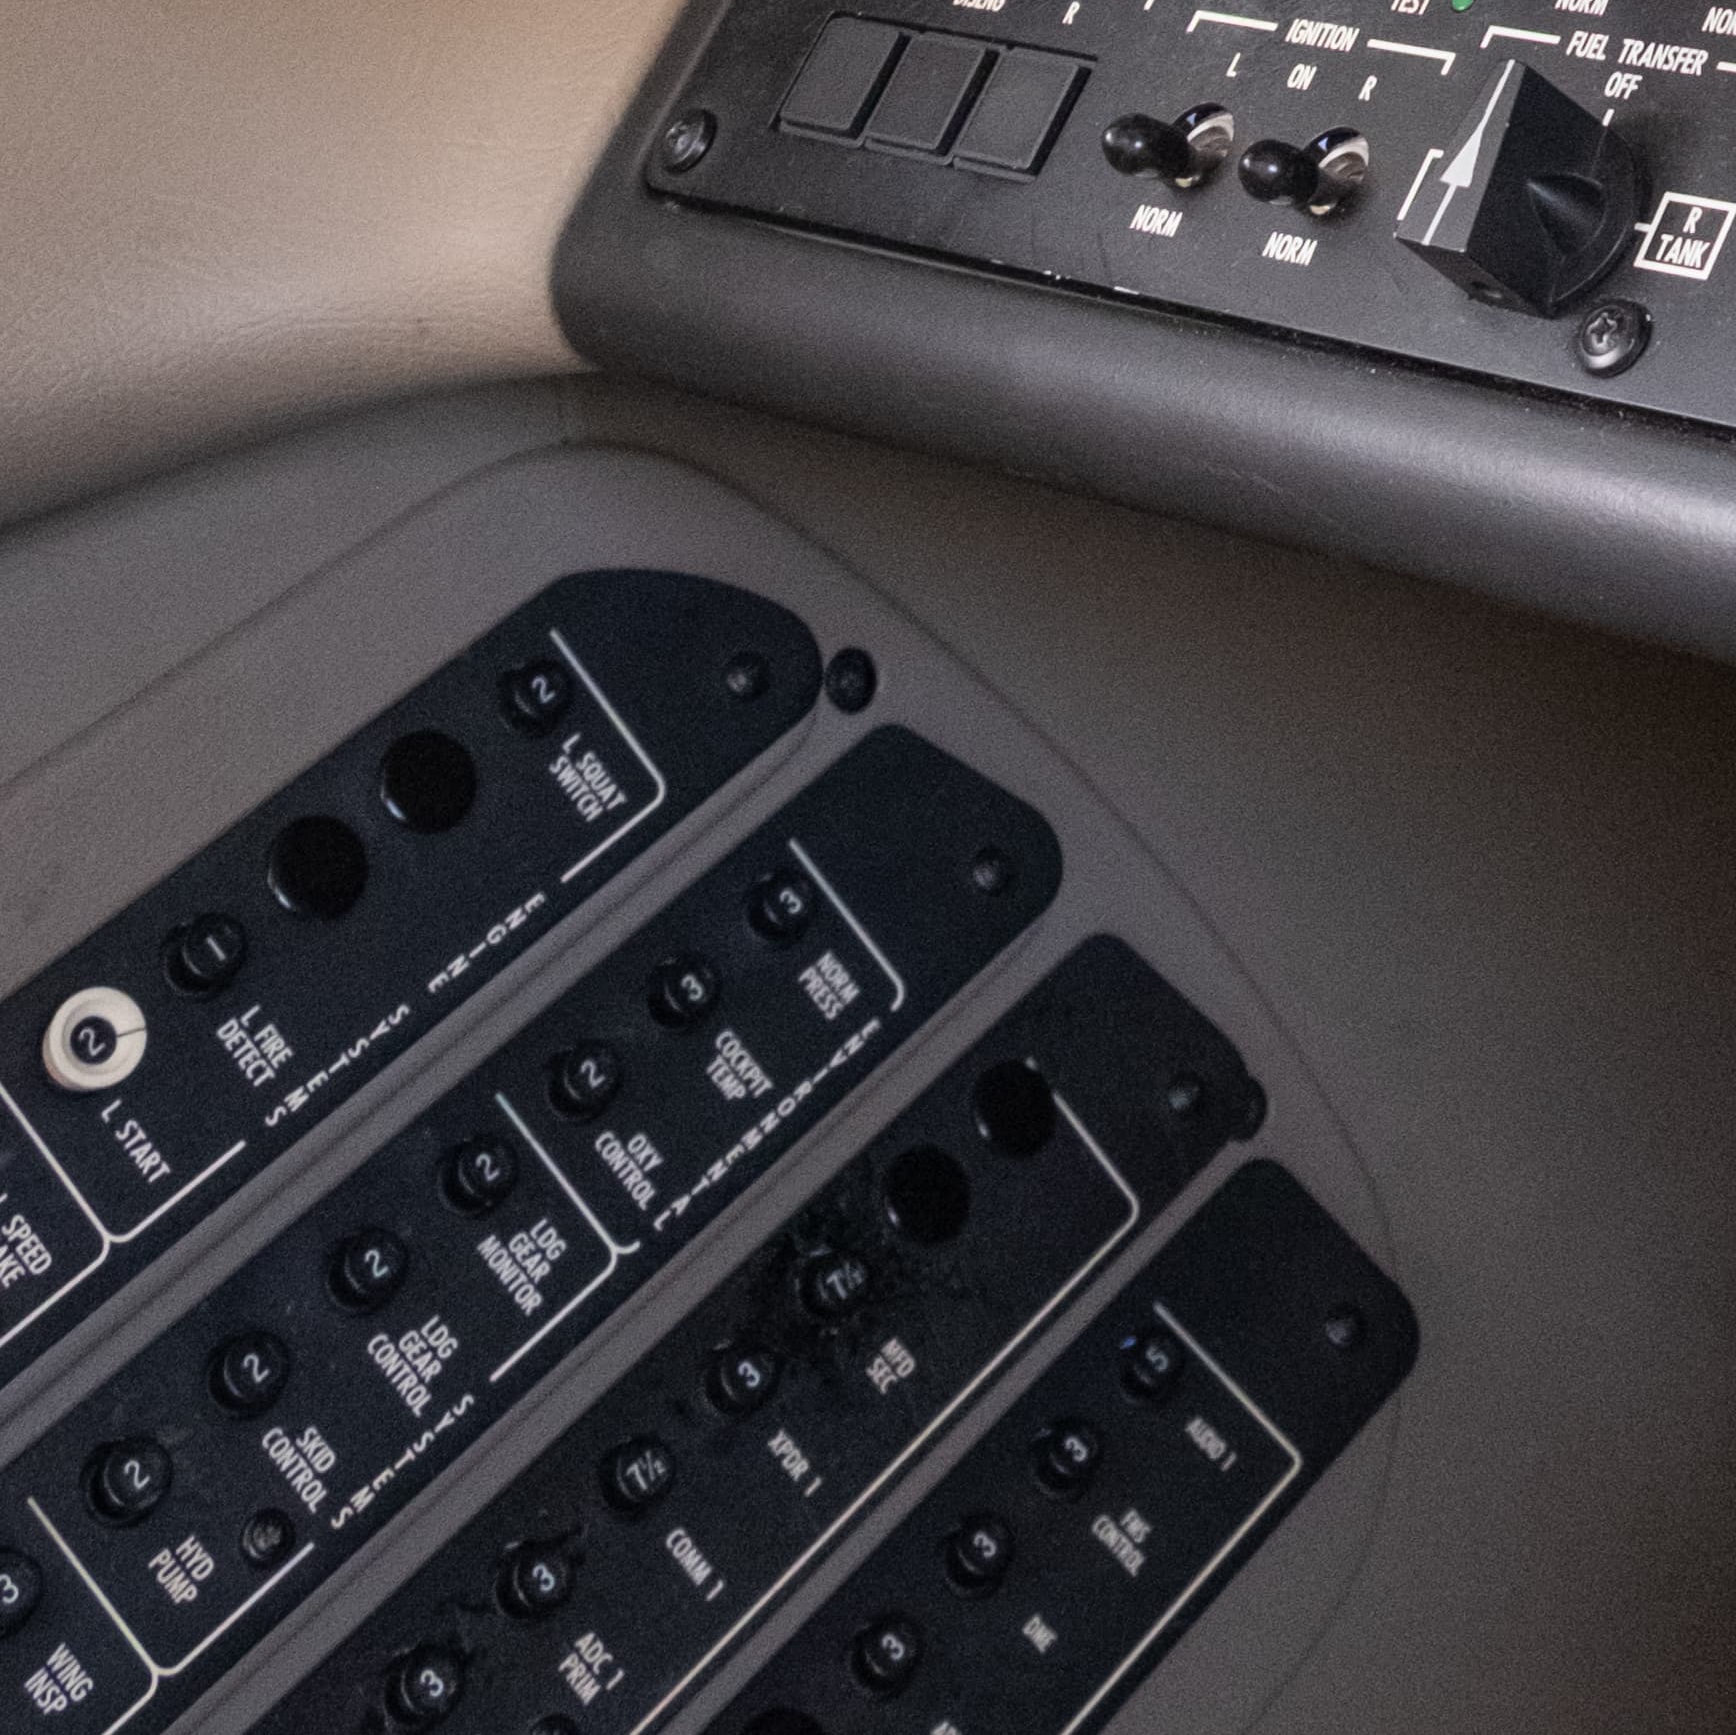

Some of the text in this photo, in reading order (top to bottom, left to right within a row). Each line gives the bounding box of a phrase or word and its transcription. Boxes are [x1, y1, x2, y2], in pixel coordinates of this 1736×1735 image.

[1285, 18, 1360, 52] IGNITION
[1617, 37, 1708, 76] TRANSFER
[1130, 204, 1318, 265] NORM NORM
[1655, 231, 1710, 270] TANK
[549, 756, 604, 822] SWITCH
[577, 751, 627, 811] SQUAT
[798, 966, 846, 1020] PRESS
[815, 949, 860, 1004] NORM
[216, 1019, 276, 1087] DETECT
[255, 1024, 294, 1069] FIRE
[116, 1120, 171, 1182] START
[594, 1131, 659, 1211] CONTROL
[477, 1235, 543, 1316] MONITOR
[508, 1232, 551, 1283] GEAR
[366, 1333, 433, 1418] CONTROL
[398, 1330, 442, 1383] GEAR
[261, 1427, 328, 1513] CONTROL
[295, 1427, 336, 1474] SKID
[46, 1642, 93, 1702] WING
